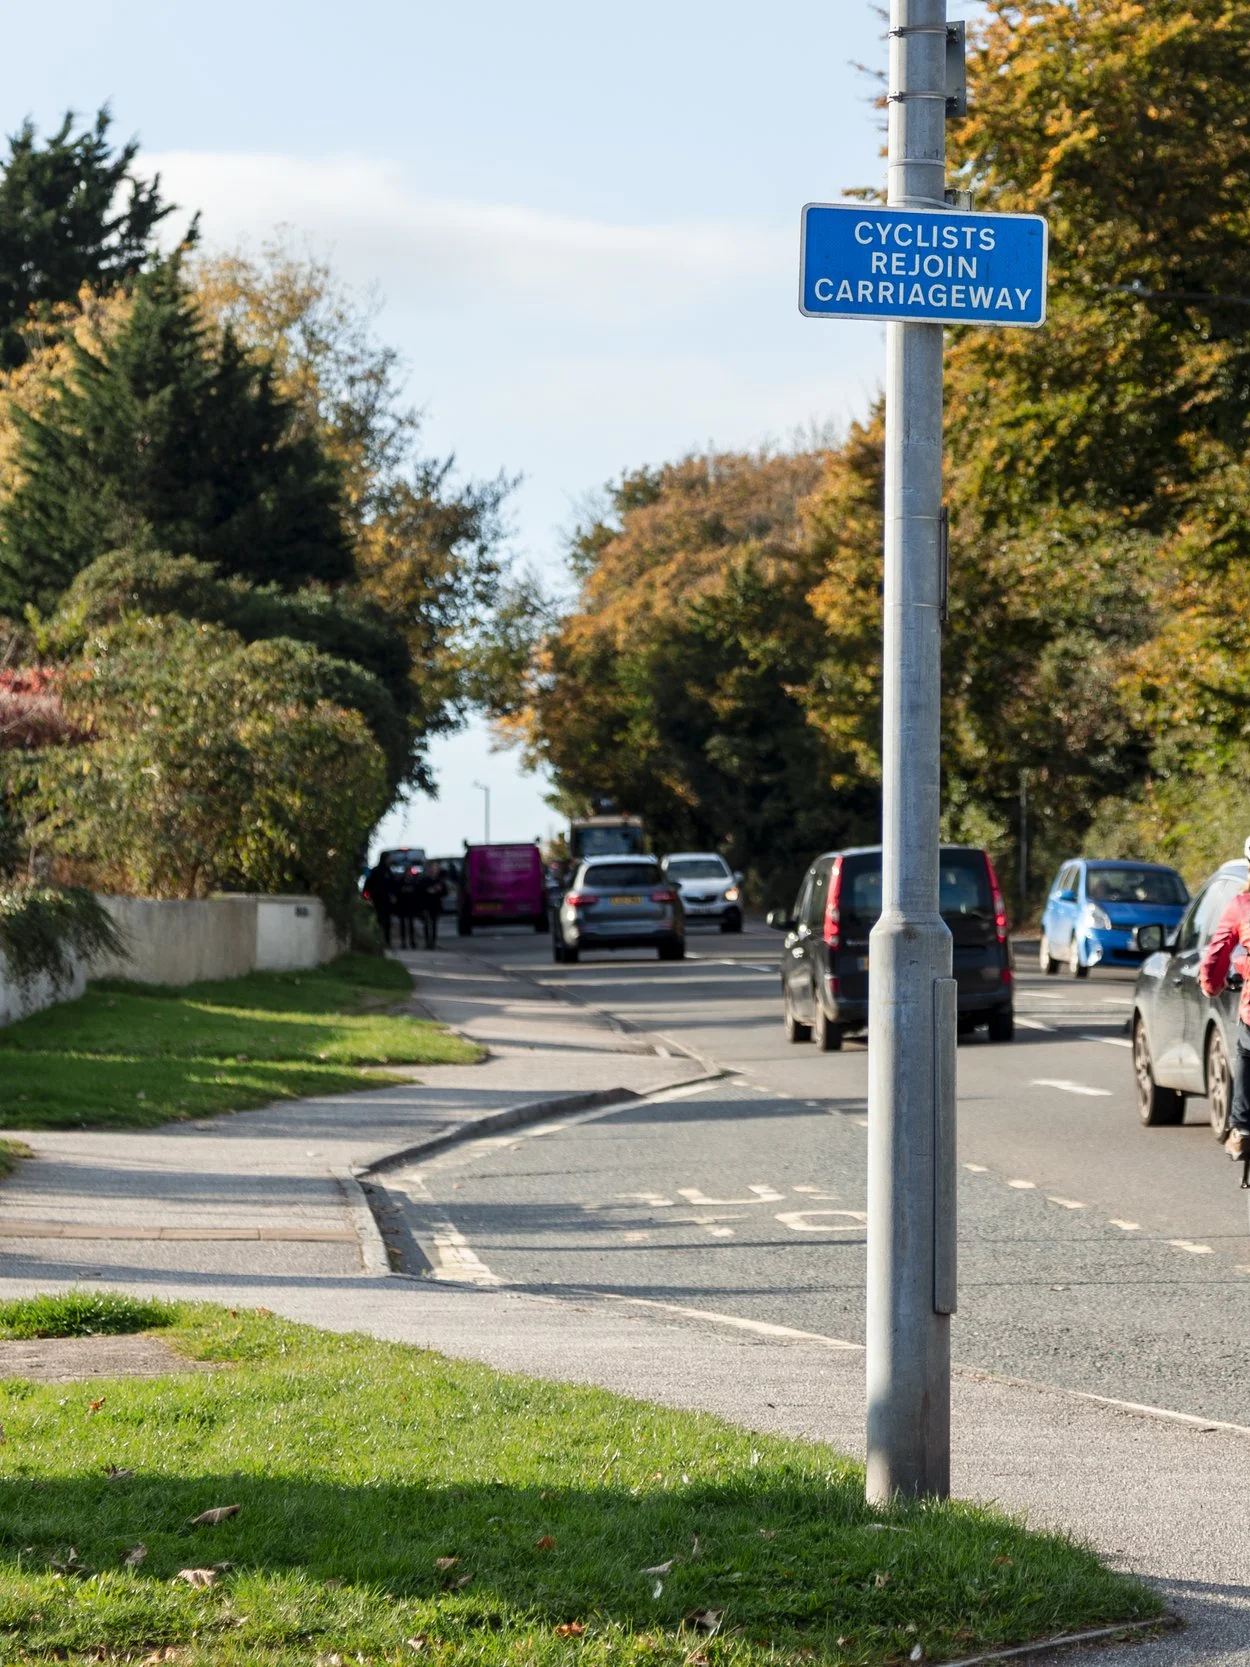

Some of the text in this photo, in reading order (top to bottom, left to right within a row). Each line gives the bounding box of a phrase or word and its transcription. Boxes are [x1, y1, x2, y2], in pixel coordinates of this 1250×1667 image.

[854, 221, 996, 251] CYCLISTS
[871, 251, 977, 279] REJOIN
[814, 278, 1032, 311] CARRIAGEWAY
